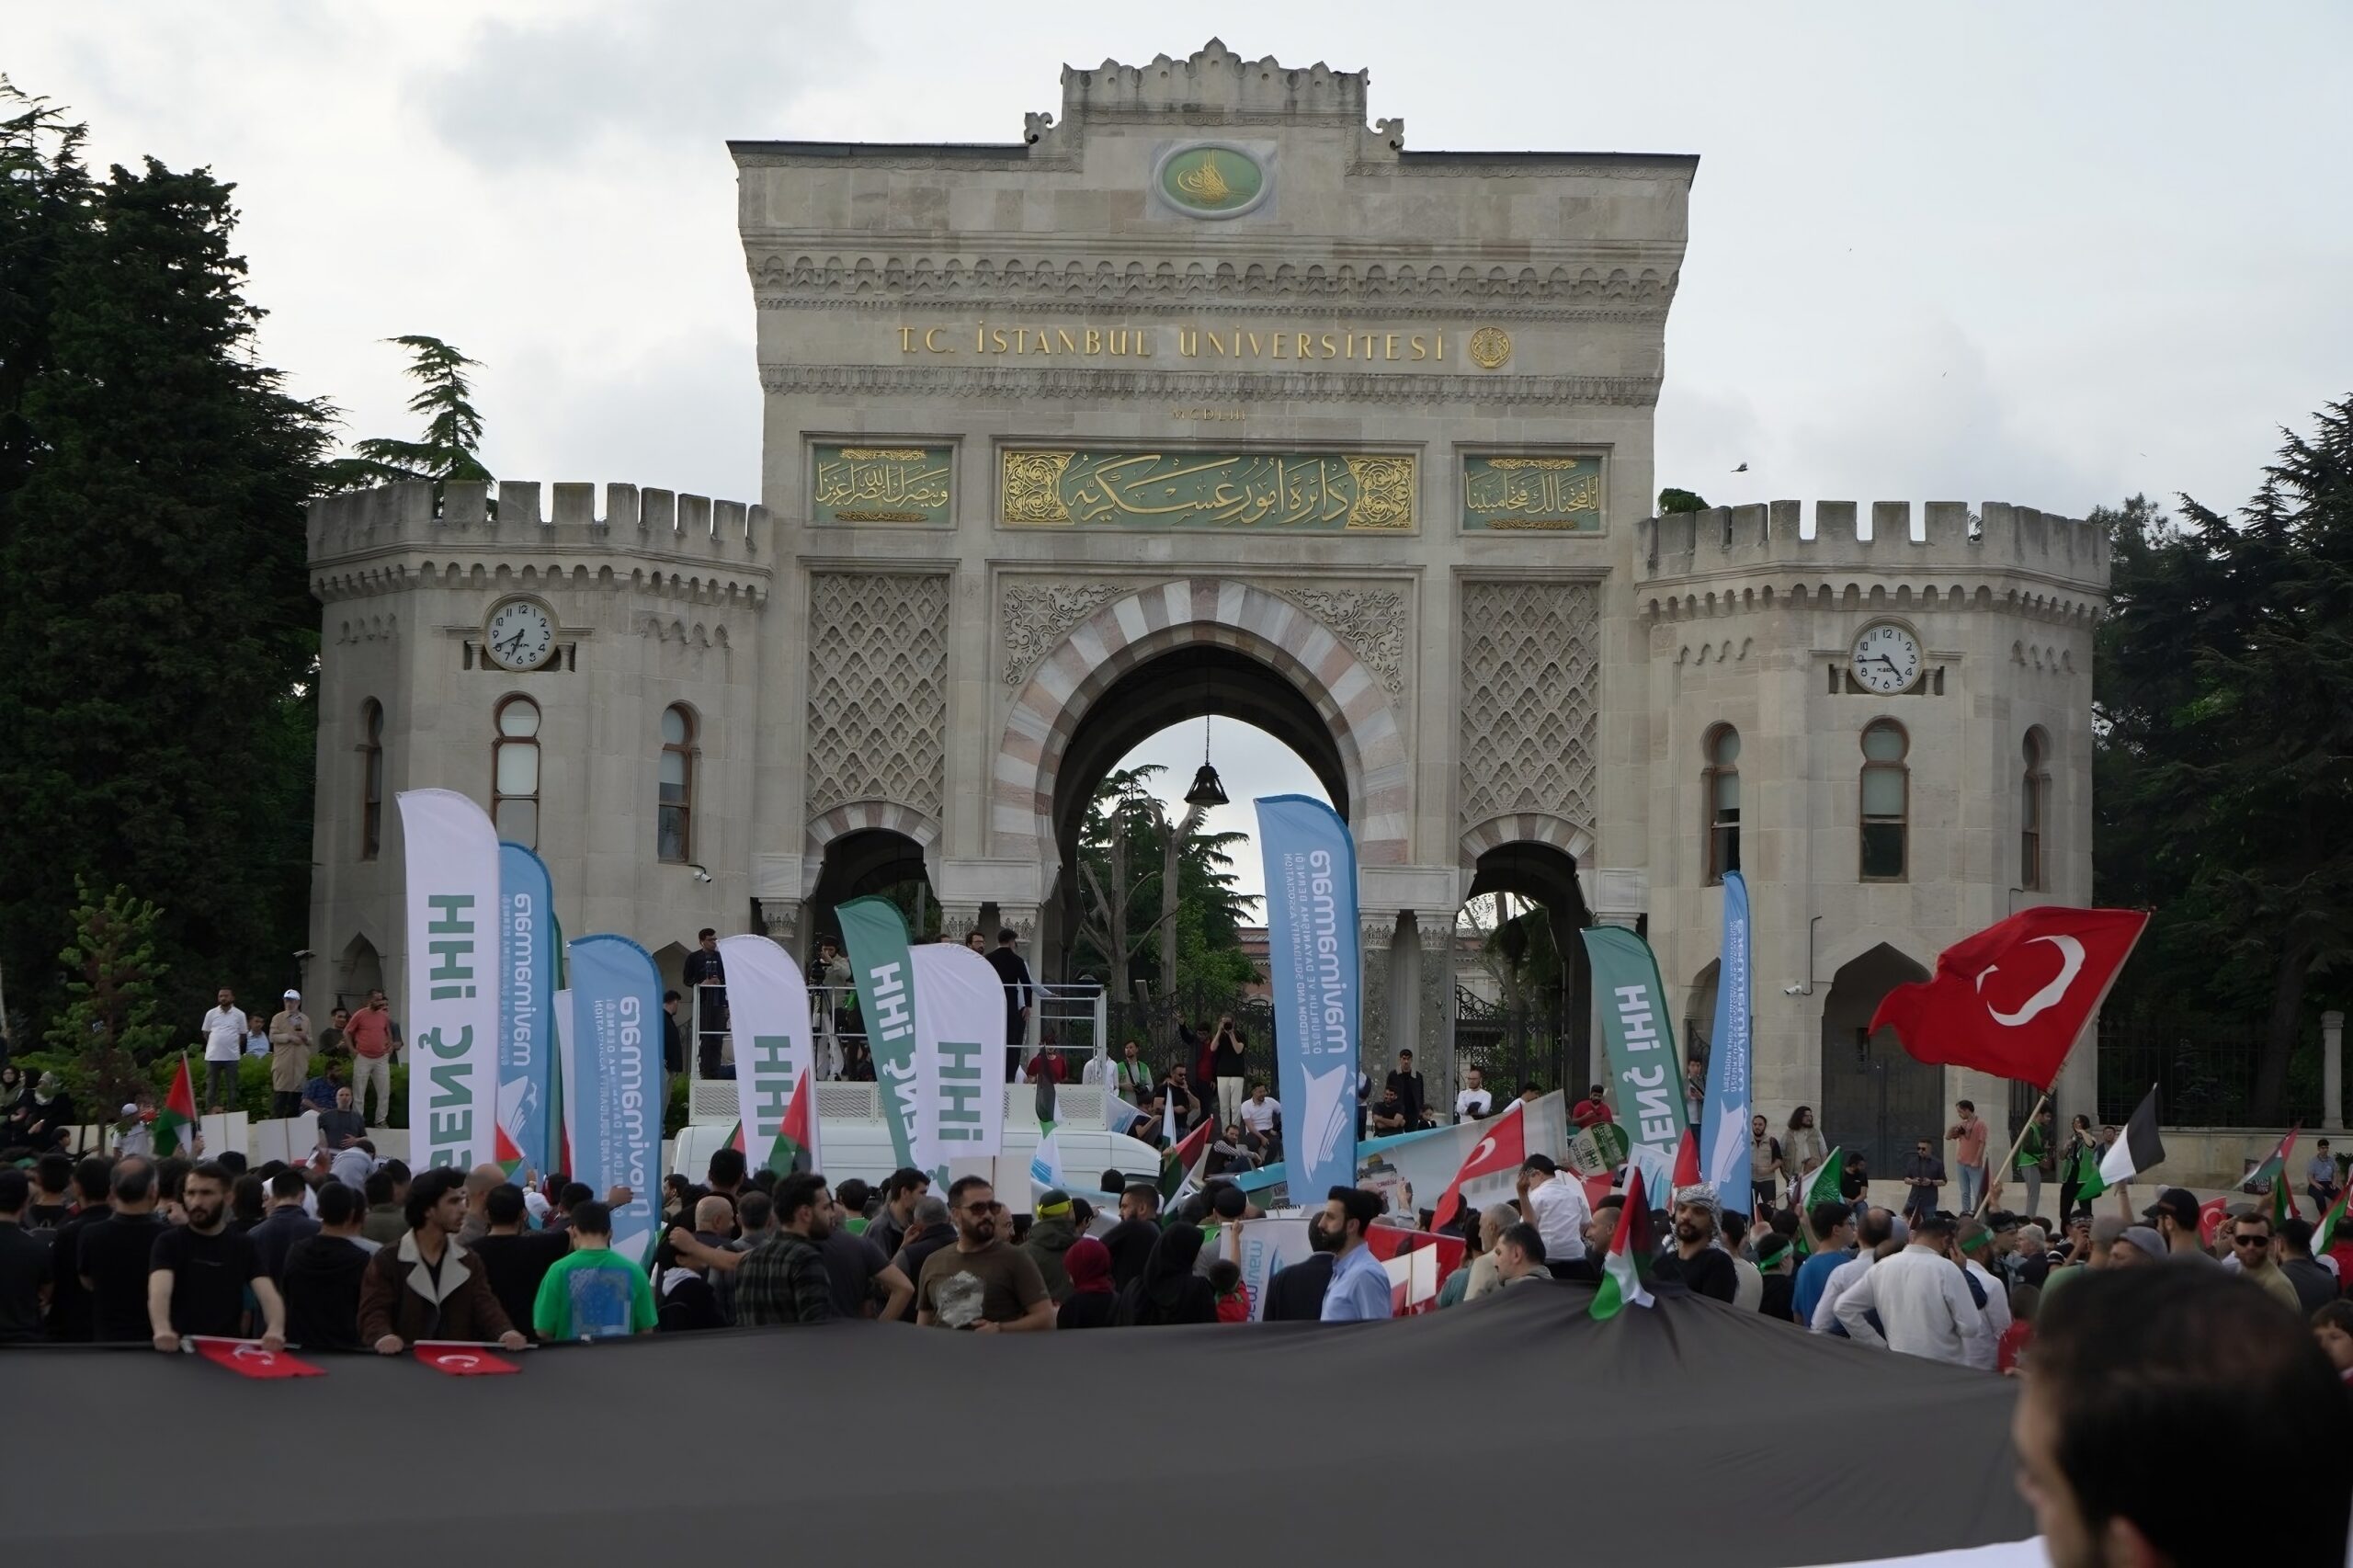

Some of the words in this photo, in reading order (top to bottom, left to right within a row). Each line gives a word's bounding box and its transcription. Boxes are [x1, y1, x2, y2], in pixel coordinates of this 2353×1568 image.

[897, 327, 955, 354] T.C.
[976, 320, 1152, 357] İSTANBUL
[1180, 324, 1443, 361] ÜNİVERSİTESİ
[518, 605, 528, 614] 12
[540, 618, 546, 627] 2
[493, 631, 499, 639] 9
[544, 631, 550, 640] 3
[1870, 631, 1877, 642] 11
[1882, 629, 1893, 639] 12
[538, 643, 546, 653] 4
[1860, 642, 1868, 651] 10
[1904, 642, 1912, 651] 2
[506, 652, 511, 661] 7
[517, 656, 524, 665] 6
[1908, 654, 1916, 664] 3
[1860, 667, 1868, 676] 8
[1904, 667, 1913, 676] 4
[1870, 676, 1877, 686] 7
[1882, 680, 1890, 689] 6
[1895, 676, 1904, 686] 5
